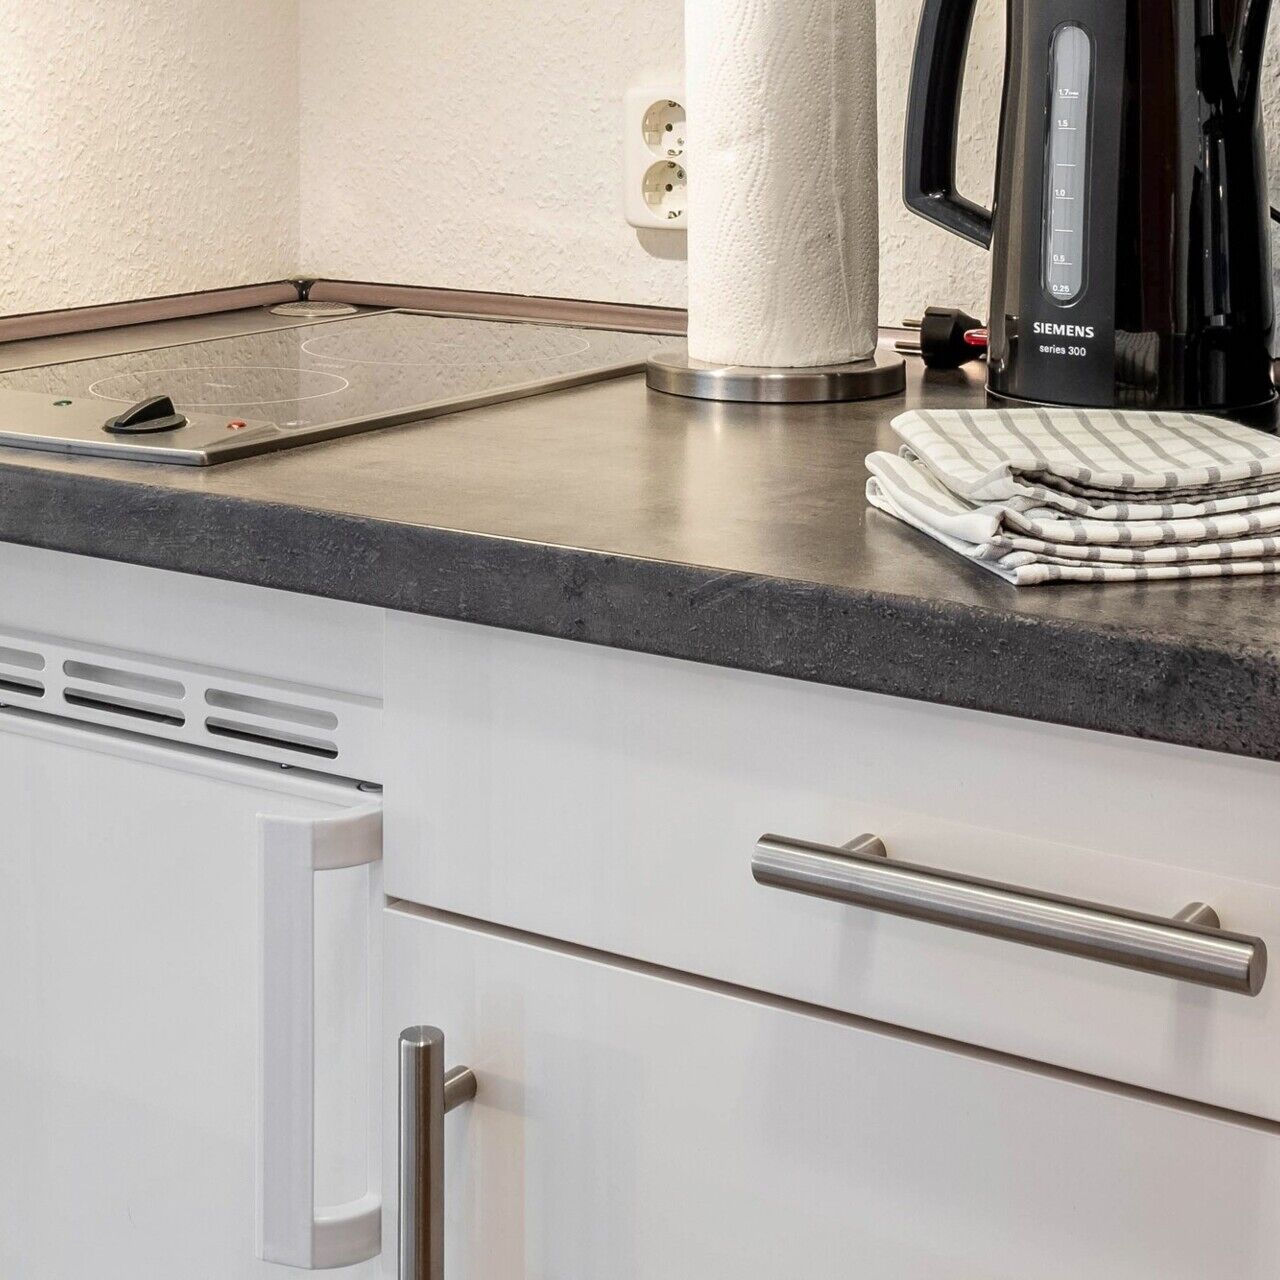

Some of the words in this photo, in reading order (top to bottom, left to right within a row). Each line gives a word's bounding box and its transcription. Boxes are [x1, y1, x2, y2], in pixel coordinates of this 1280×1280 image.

[1033, 321, 1095, 338] SIEMENS
[1039, 344, 1066, 355] series
[1068, 345, 1087, 357] 300
